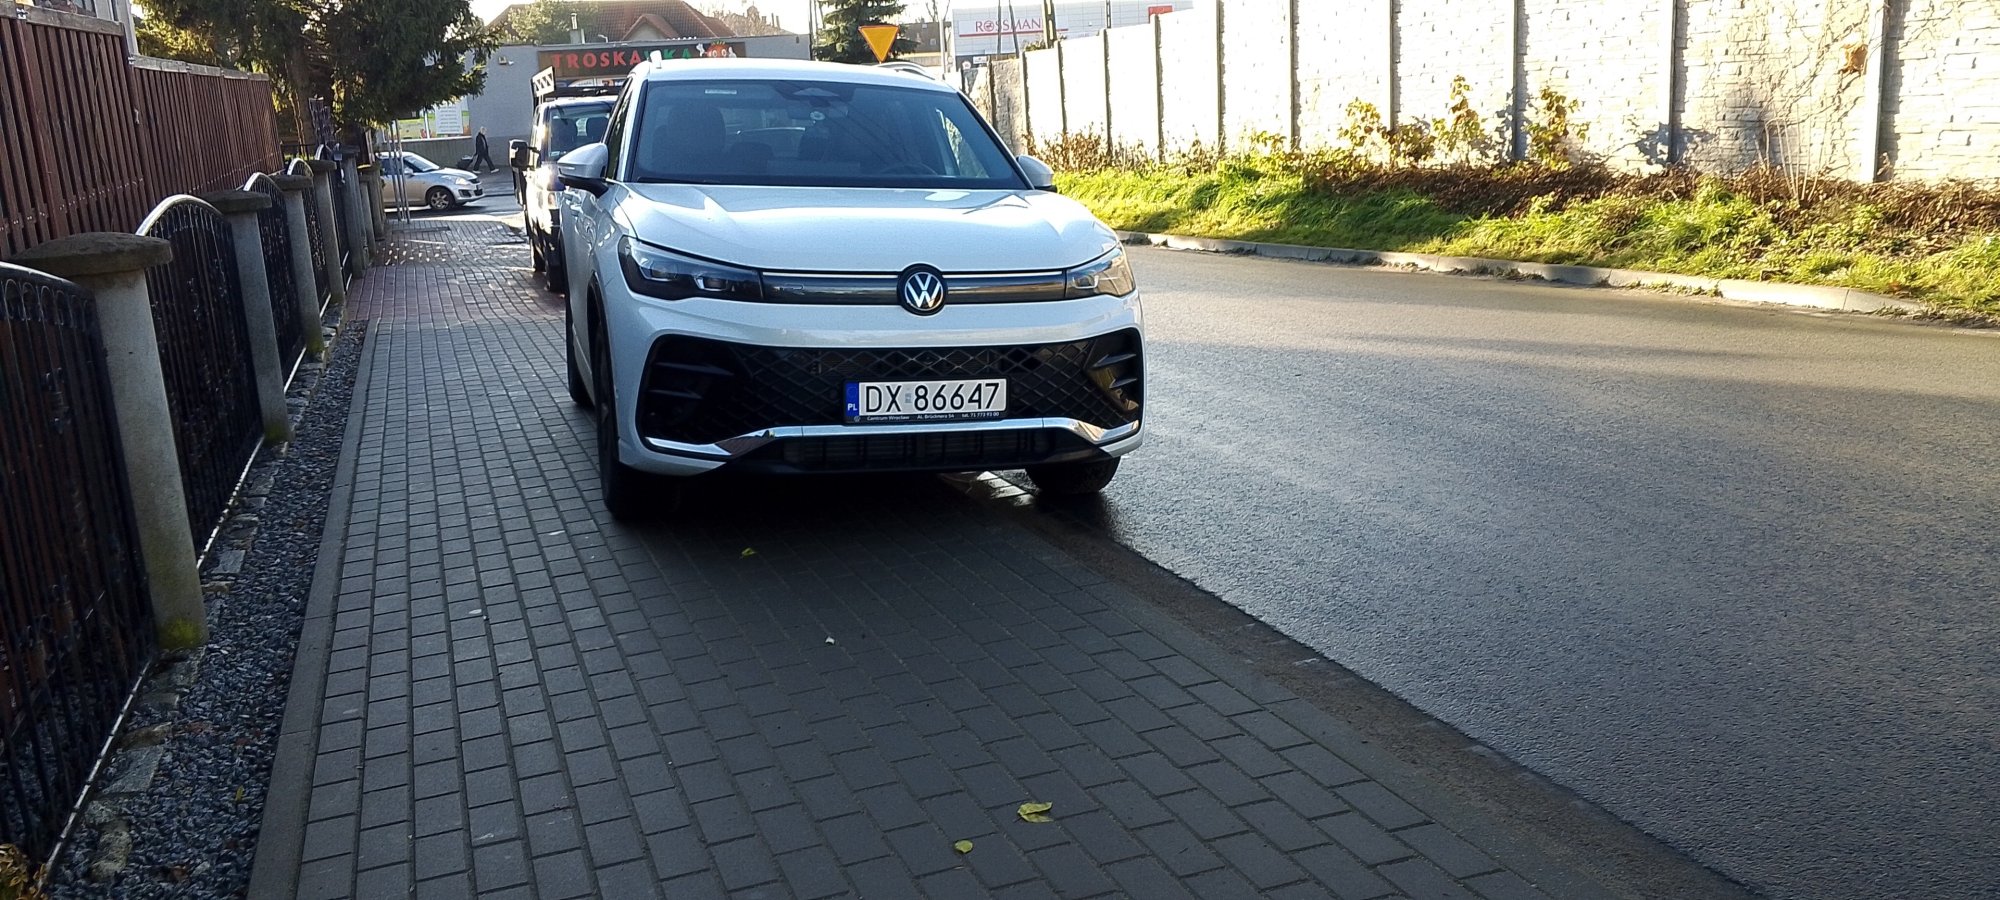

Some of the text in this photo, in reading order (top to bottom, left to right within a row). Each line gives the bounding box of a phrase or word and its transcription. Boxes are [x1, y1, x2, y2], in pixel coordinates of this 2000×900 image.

[975, 18, 1043, 32] ROSSMAN
[865, 382, 1000, 413] DX 86647
[847, 403, 858, 411] PL
